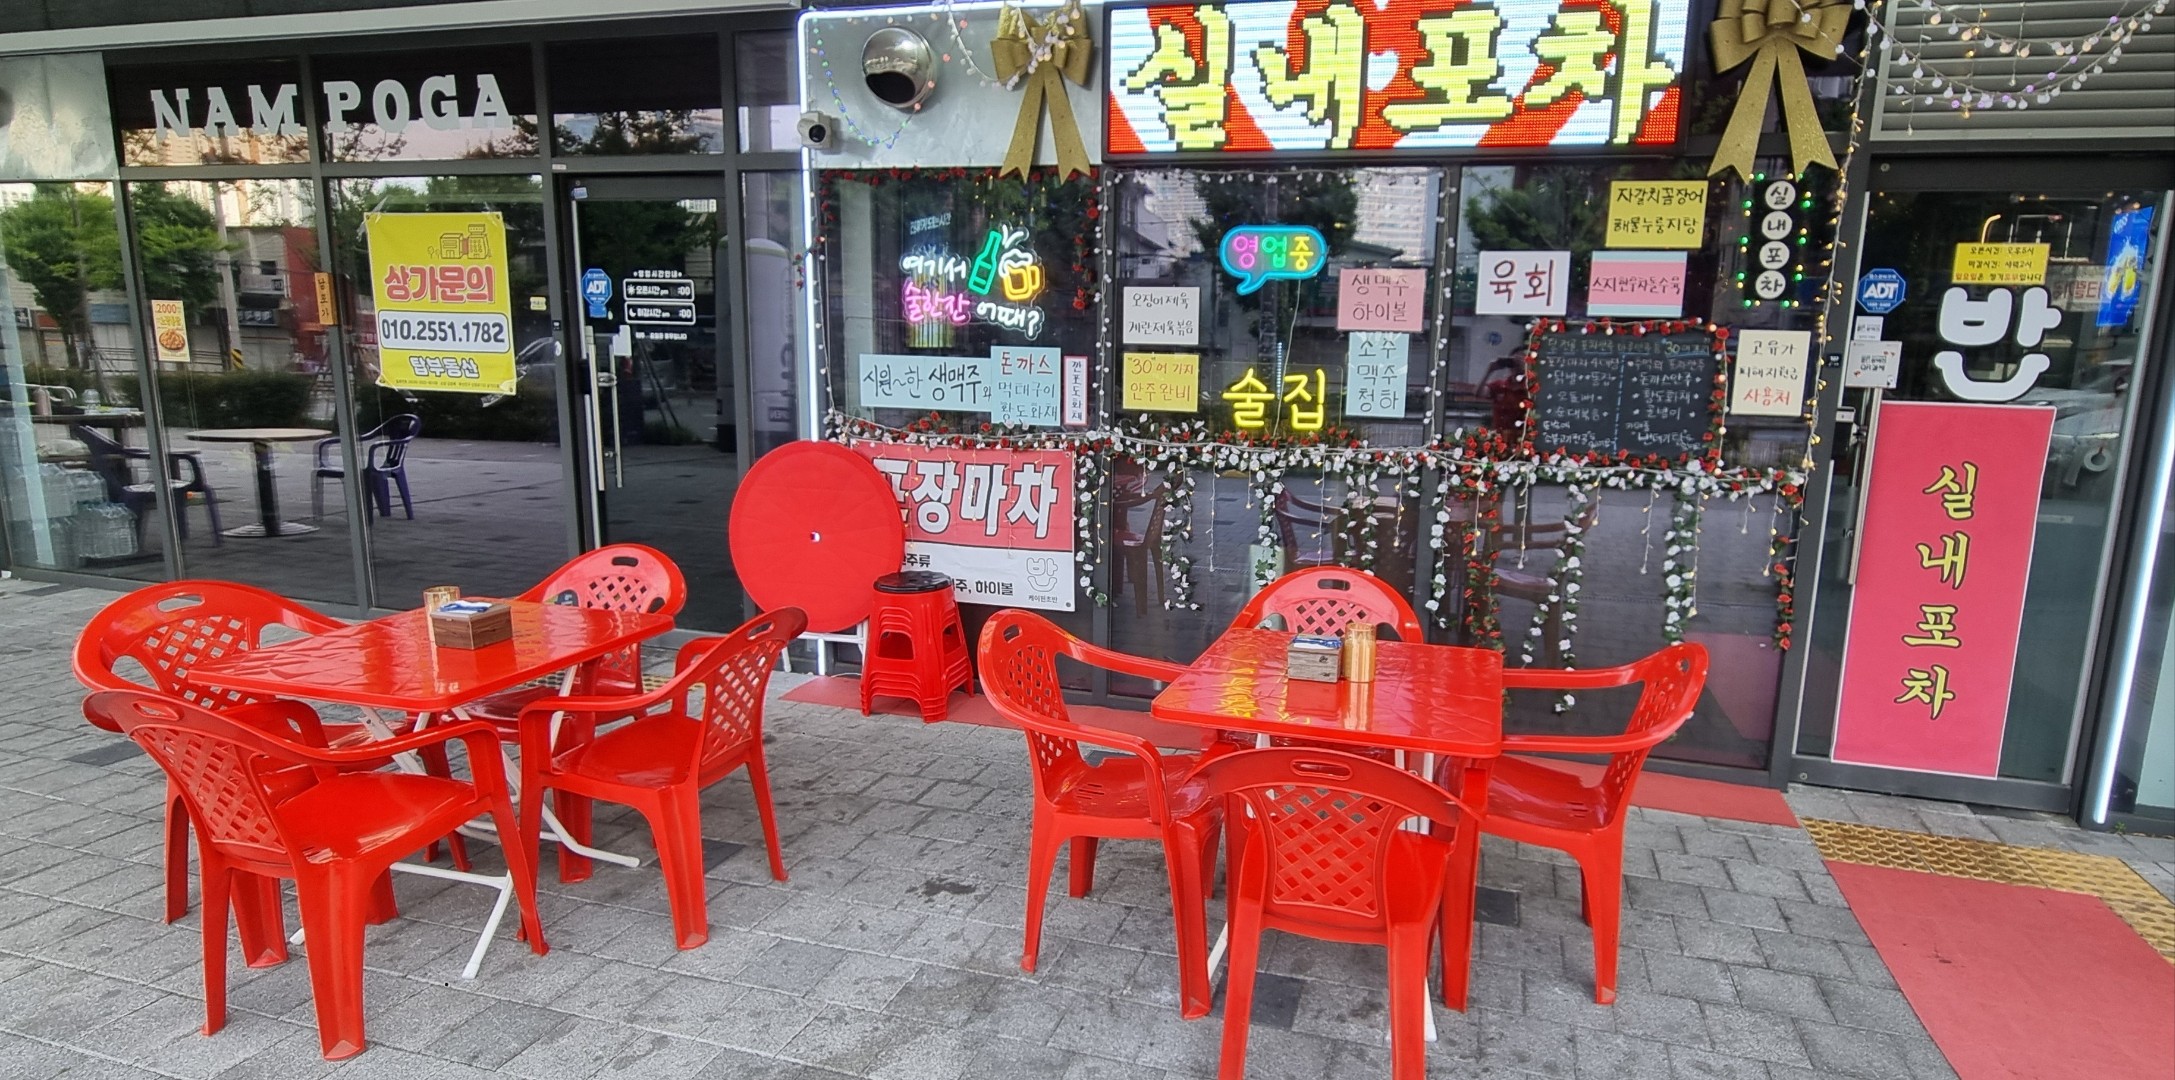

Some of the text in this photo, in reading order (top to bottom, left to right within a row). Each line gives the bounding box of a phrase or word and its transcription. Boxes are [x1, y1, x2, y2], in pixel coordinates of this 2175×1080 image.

[1120, 0, 1675, 148] 실내포차
[150, 74, 513, 139] NAM POGA
[1616, 187, 1704, 205] 자갈치꼼장어
[1613, 216, 1699, 235] 해물누룽지탕
[1760, 185, 1789, 292] 실내포차
[1232, 235, 1314, 270] 영업중
[902, 255, 967, 281] 여기서
[384, 265, 496, 303] 상가문의
[587, 280, 607, 294] ADT
[1351, 274, 1409, 296] 생맥주
[1489, 259, 1554, 306] 육회
[1863, 282, 1899, 299] ADT
[155, 303, 177, 313] 2000
[977, 301, 1040, 337] 어때?
[1352, 301, 1408, 322] 하이볼
[381, 318, 505, 343] 010.2551.1782
[1358, 337, 1396, 359] 소주
[1752, 340, 1797, 356] 고유가
[1934, 287, 2062, 401] 반
[1001, 352, 1053, 375] 돈까스
[1739, 366, 1798, 380] 피해지원금
[863, 363, 923, 399] 시원~한
[1357, 364, 1398, 386] 맥주
[998, 381, 1055, 398] 먹태구이
[1071, 360, 1083, 420] 깐포도화채
[1222, 368, 1326, 430] 술집
[1358, 388, 1399, 412] 청하
[1743, 386, 1791, 406] 사용처
[1000, 401, 1058, 422] 황도화채
[902, 553, 931, 567] 주류
[951, 578, 1014, 597] 주, 하이볼
[1894, 460, 1979, 720] 실내포차
